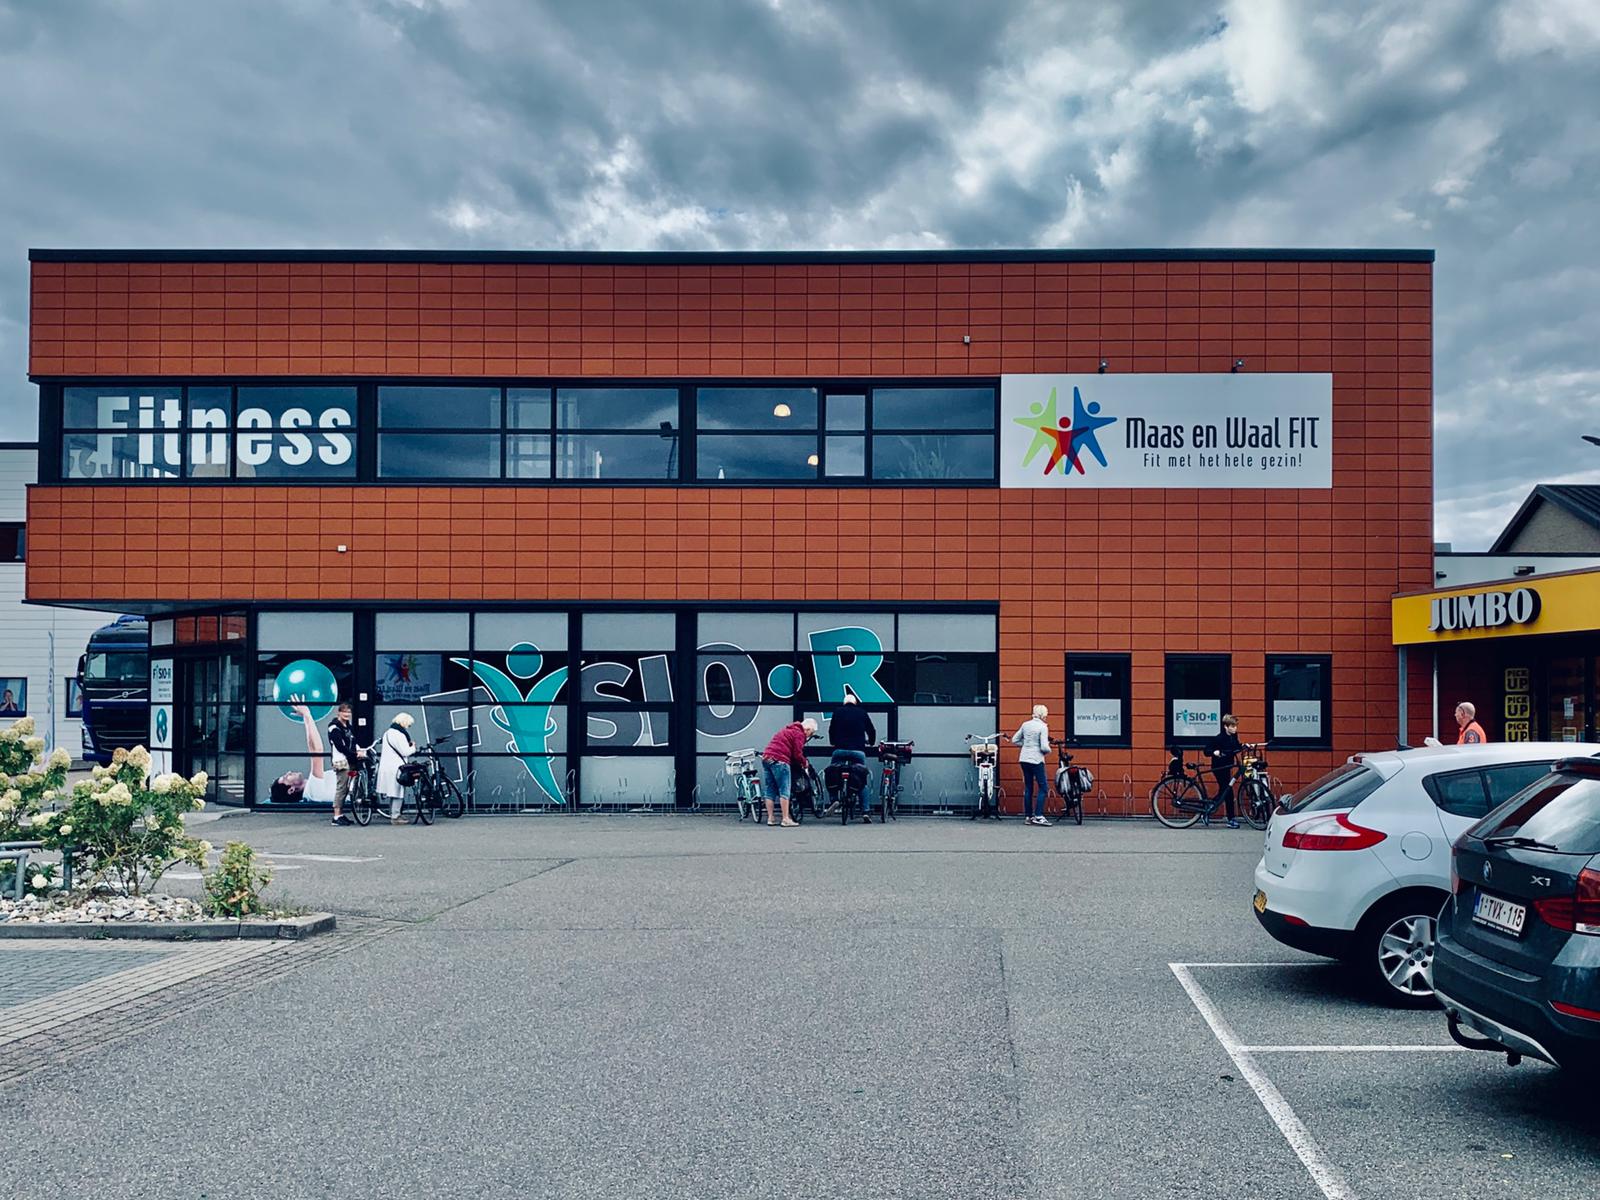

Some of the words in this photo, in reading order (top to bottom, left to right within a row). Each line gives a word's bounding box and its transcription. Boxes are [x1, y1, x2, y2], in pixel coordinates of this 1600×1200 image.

[97, 396, 352, 466] Fitness
[1126, 417, 1184, 449] Maas
[1192, 425, 1217, 449] en
[1226, 417, 1281, 449] Waal
[1289, 417, 1319, 449] FIT
[1143, 453, 1161, 467] Fit
[1168, 454, 1191, 467] met
[1199, 453, 1220, 467] het
[1224, 453, 1253, 467] hele
[1261, 453, 1302, 470] gezin!
[1428, 587, 1539, 633] JUMBO
[1507, 678, 1528, 689] UP
[1507, 704, 1528, 716] UP
[1508, 731, 1528, 742] UP
[1530, 875, 1551, 887] X1
